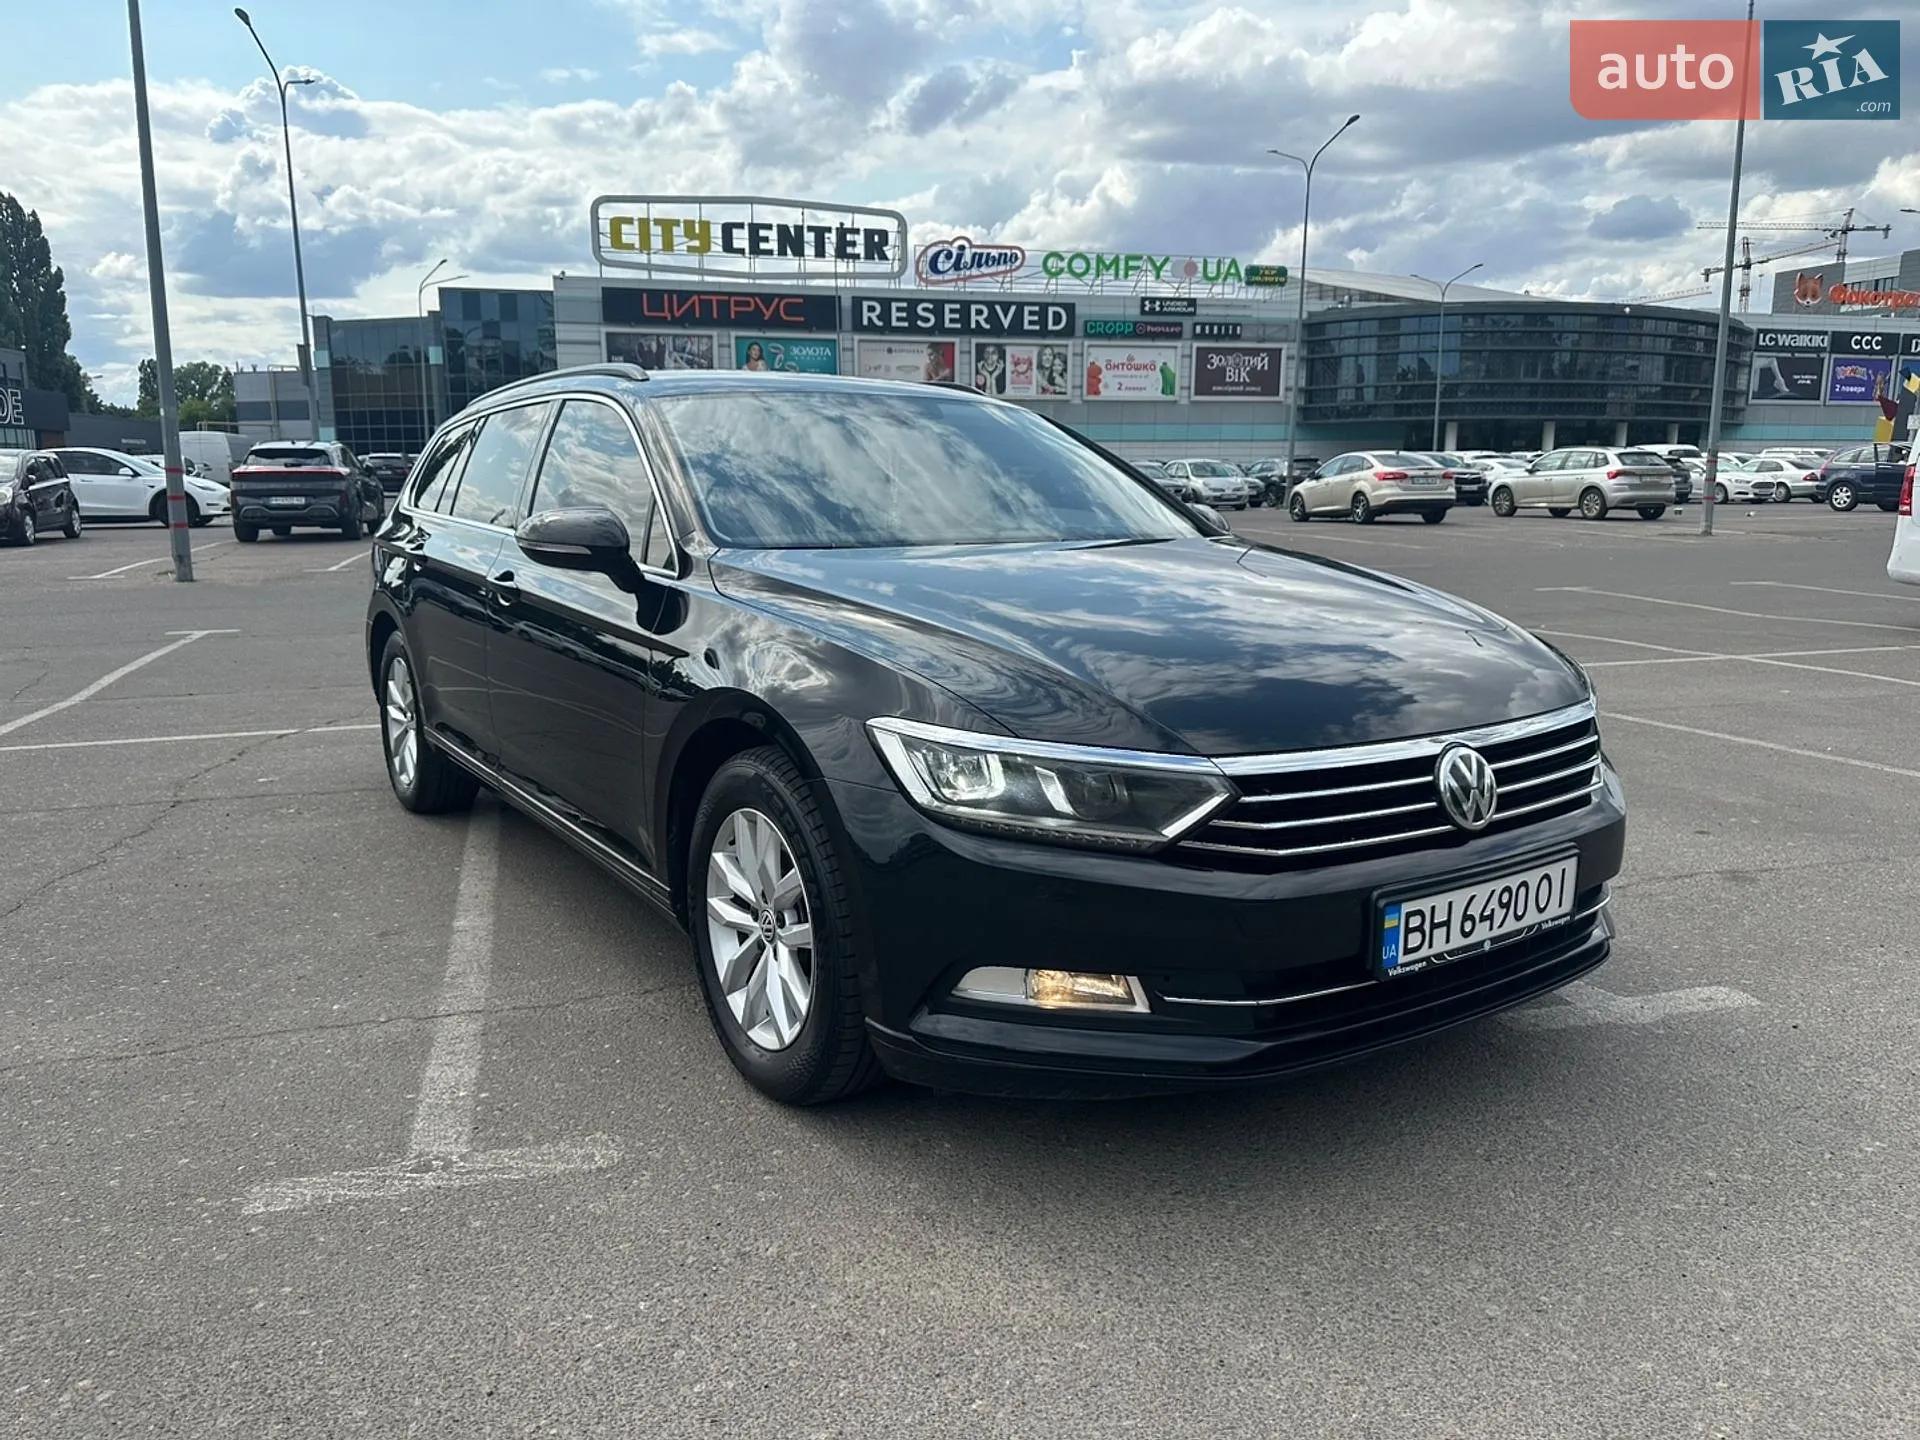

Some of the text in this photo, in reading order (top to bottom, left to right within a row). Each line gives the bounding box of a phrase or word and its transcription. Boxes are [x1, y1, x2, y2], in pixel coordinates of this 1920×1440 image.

[609, 216, 889, 262] CITY CENTER
[929, 244, 1019, 275] Сільпо
[1042, 251, 1243, 282] COMFY UA
[641, 292, 805, 321] ЦИТРУС
[861, 300, 1069, 331] RESERVED
[1086, 321, 1133, 334] CROPP
[1758, 332, 1776, 345] LC
[1850, 335, 1883, 350] CCC
[1226, 367, 1251, 383] ВІК
[1835, 384, 1840, 392] 2
[1403, 900, 1453, 955] BH
[1460, 880, 1529, 939] 6490
[1382, 944, 1398, 959] UA
